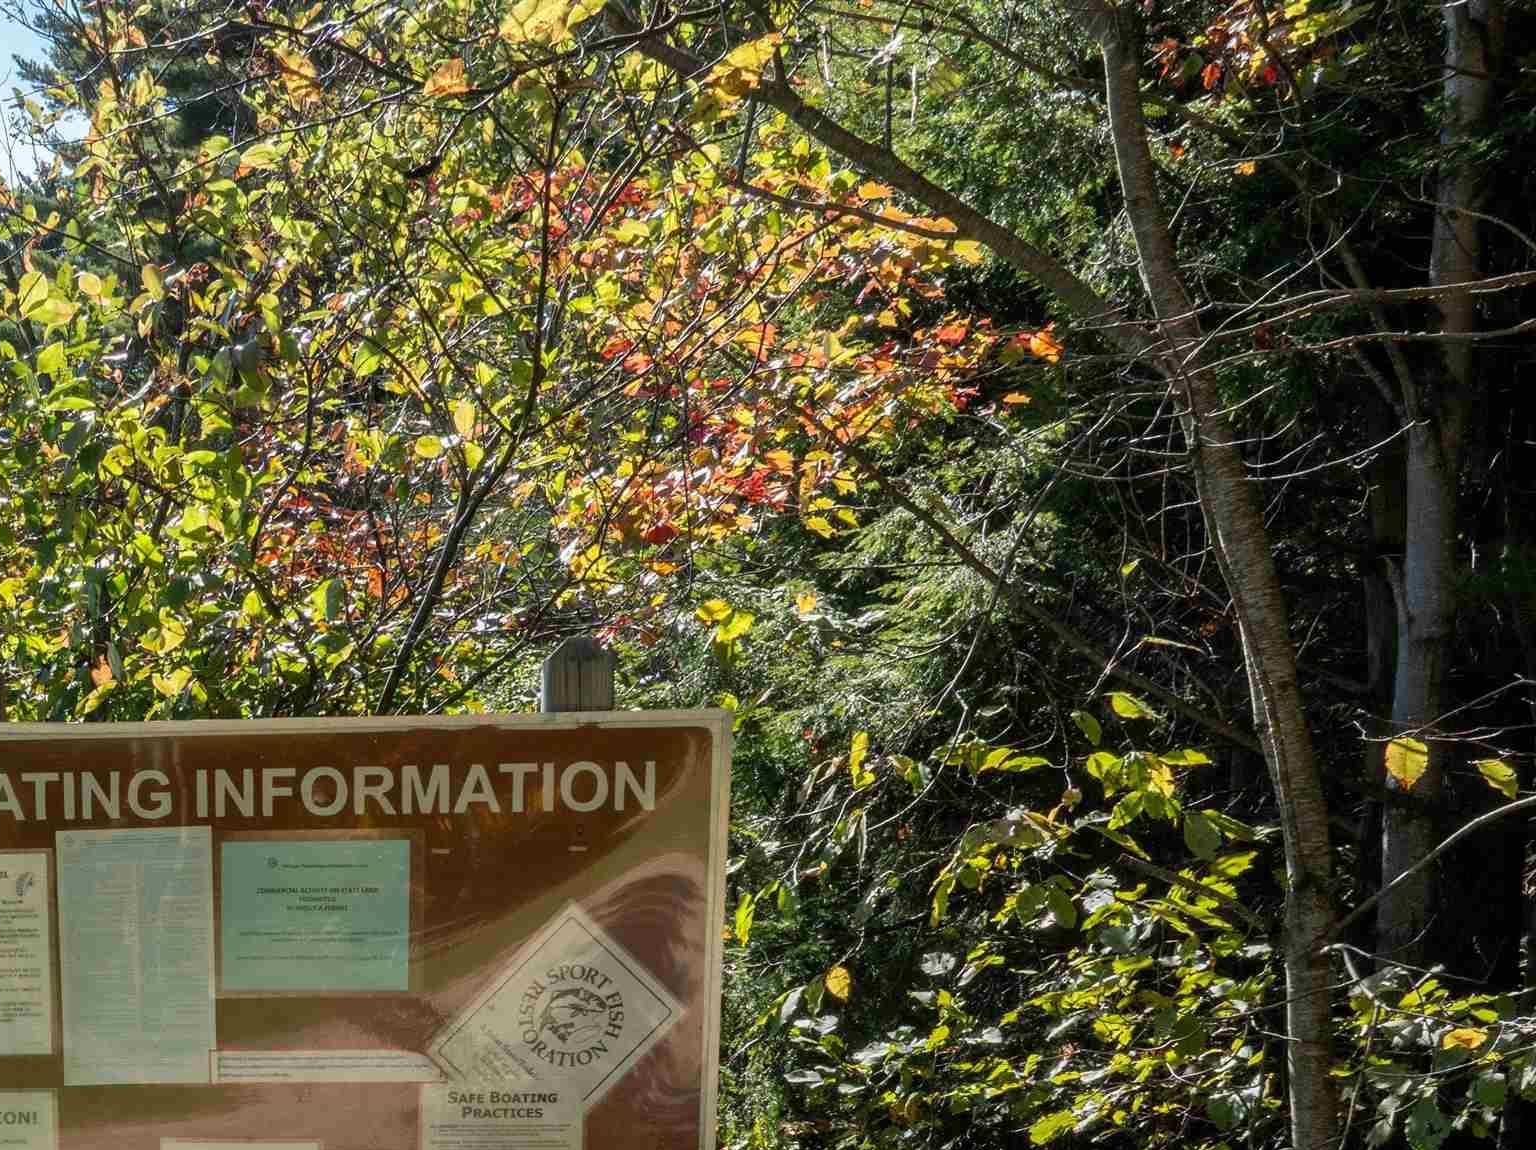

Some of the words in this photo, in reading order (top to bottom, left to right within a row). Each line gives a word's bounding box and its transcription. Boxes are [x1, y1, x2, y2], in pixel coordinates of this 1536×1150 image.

[196, 760, 657, 818] INFORMATION
[546, 964, 613, 990] SPORT
[605, 990, 625, 1040] FISH
[447, 1090, 485, 1105] SAFE
[489, 1090, 558, 1105] BOATING
[462, 1106, 545, 1120] PRACTICES
